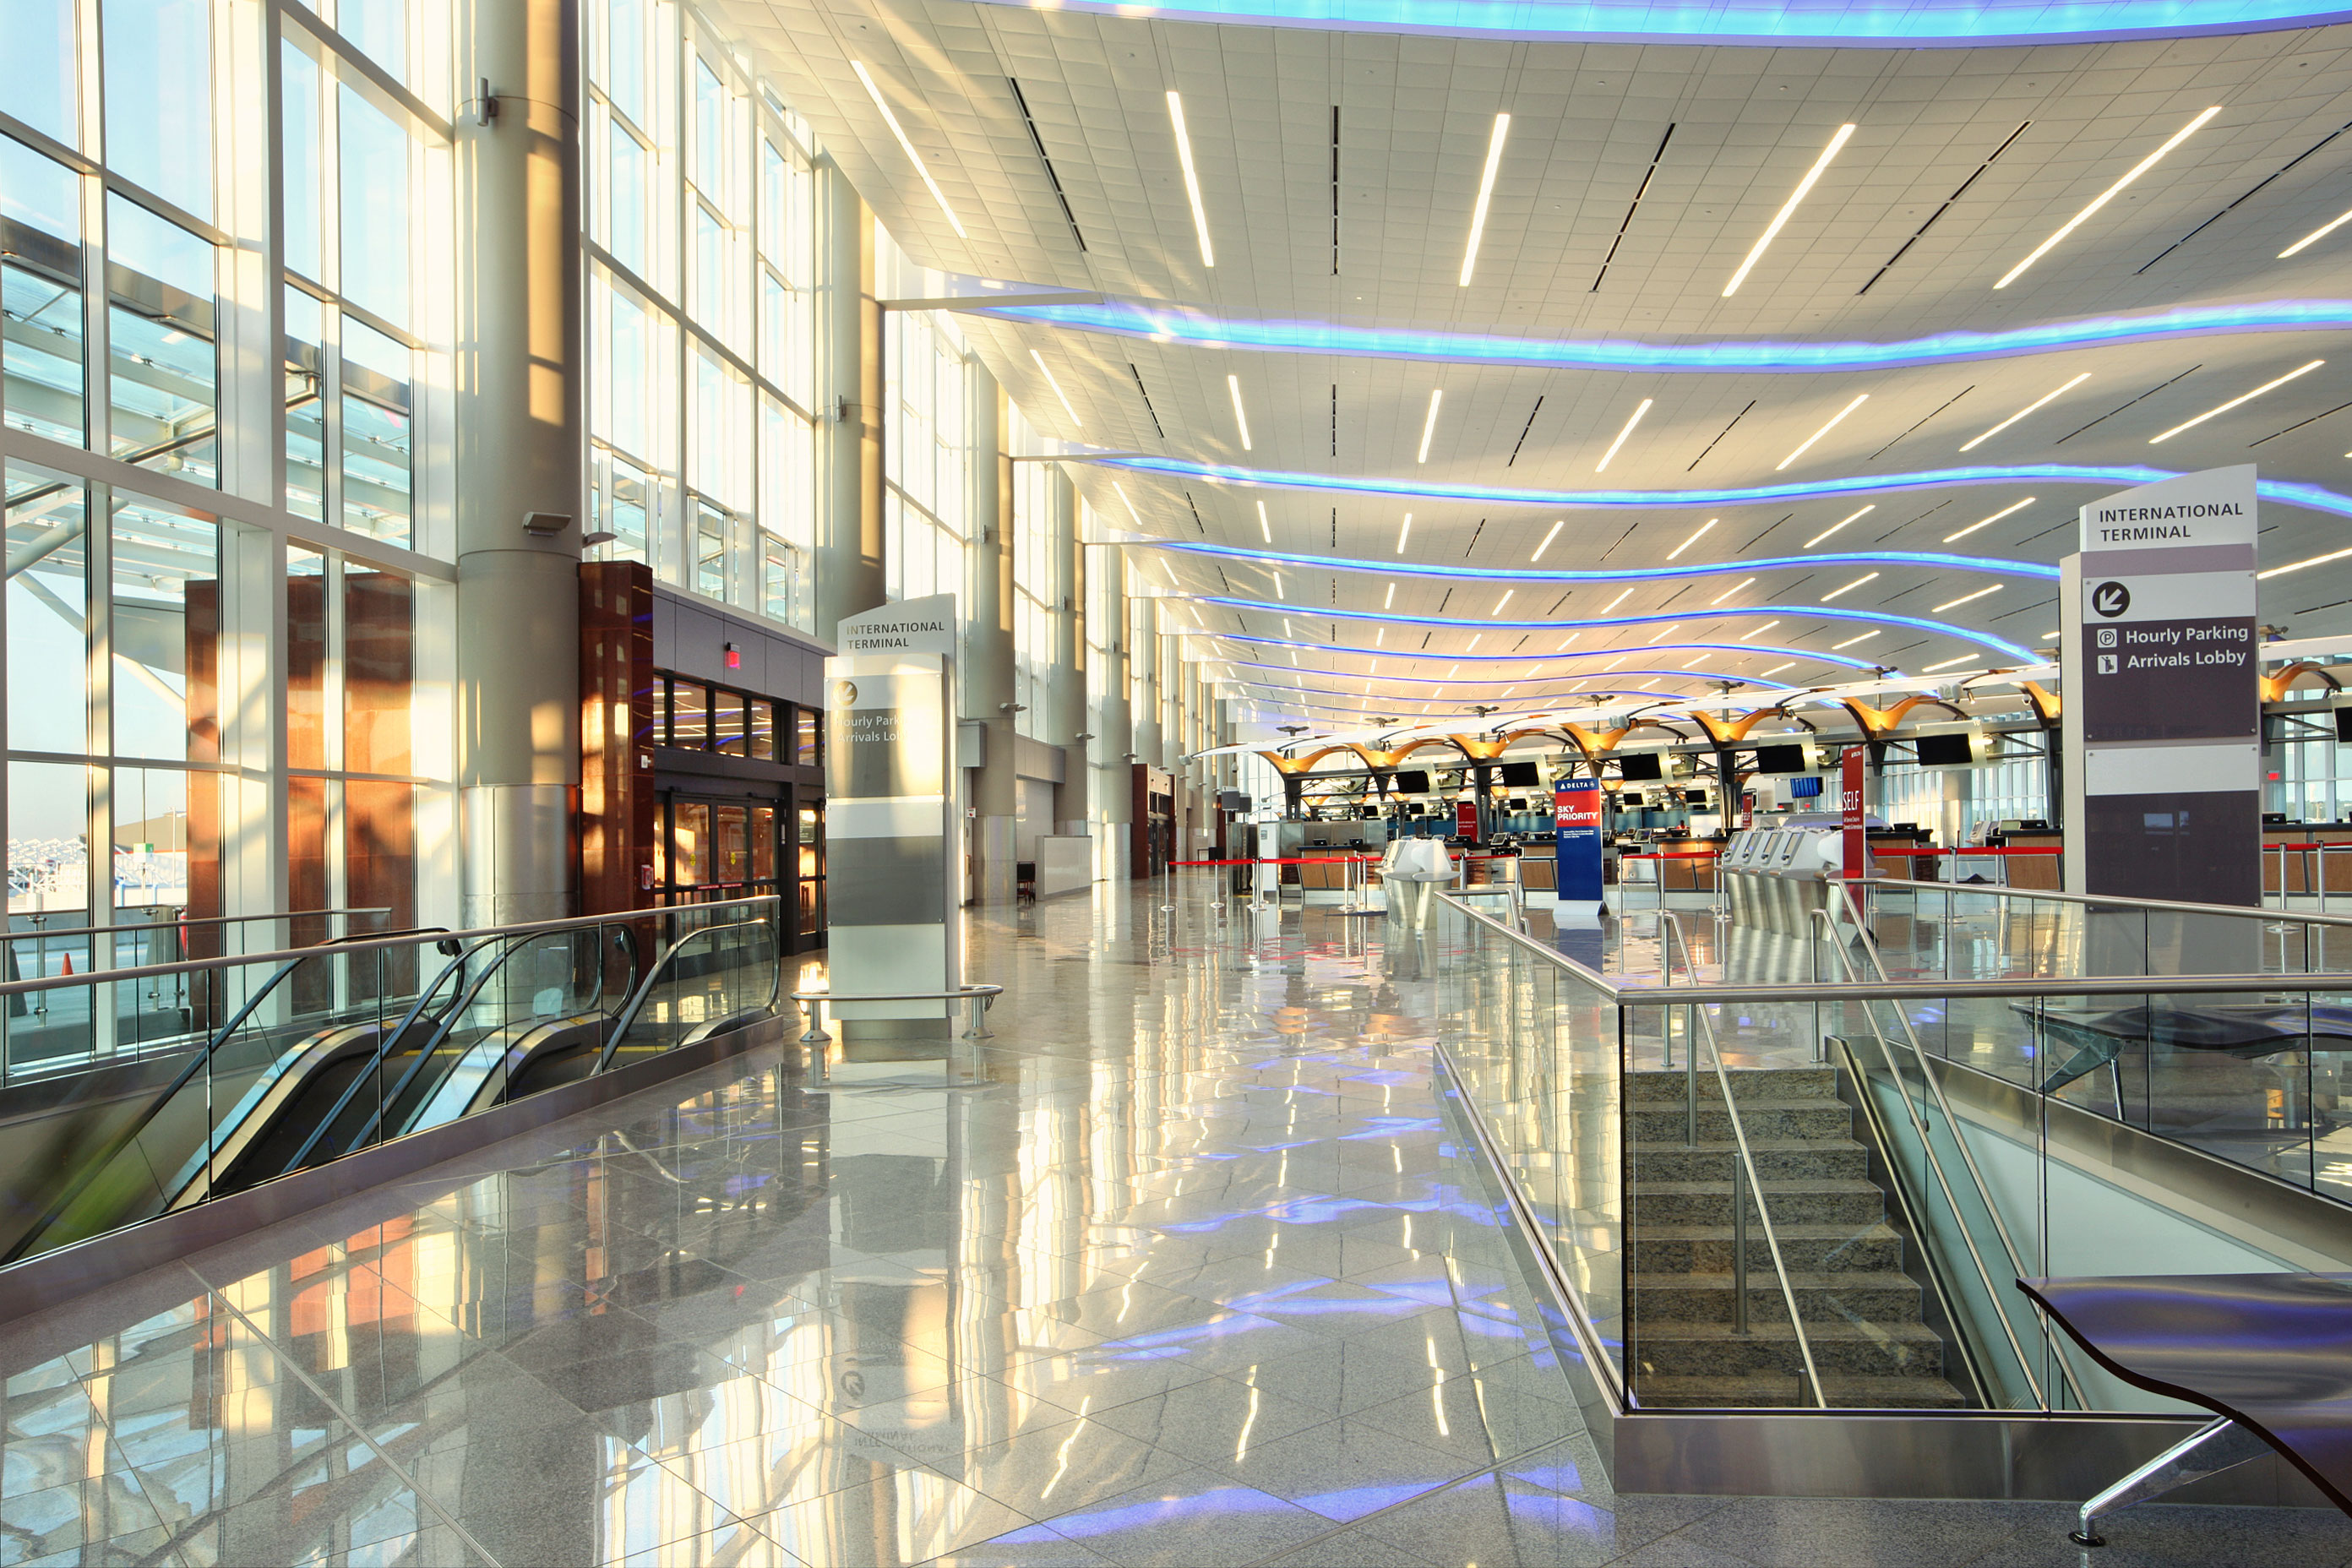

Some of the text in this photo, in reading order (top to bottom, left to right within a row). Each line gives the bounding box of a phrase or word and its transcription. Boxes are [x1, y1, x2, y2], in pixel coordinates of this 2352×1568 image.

[2099, 503, 2243, 522] INTERNATIONAL
[2100, 525, 2191, 542] TERMINAL
[847, 622, 945, 635] INTERNATIONAL
[2126, 628, 2180, 645] Hourly
[2186, 625, 2249, 642] Parking
[847, 637, 909, 649] TERMINAL
[2126, 649, 2246, 668] Arrivals Lobby
[838, 731, 880, 743] Arrivals
[1843, 791, 1859, 811] SELF
[1557, 812, 1598, 820] PRIORITY
